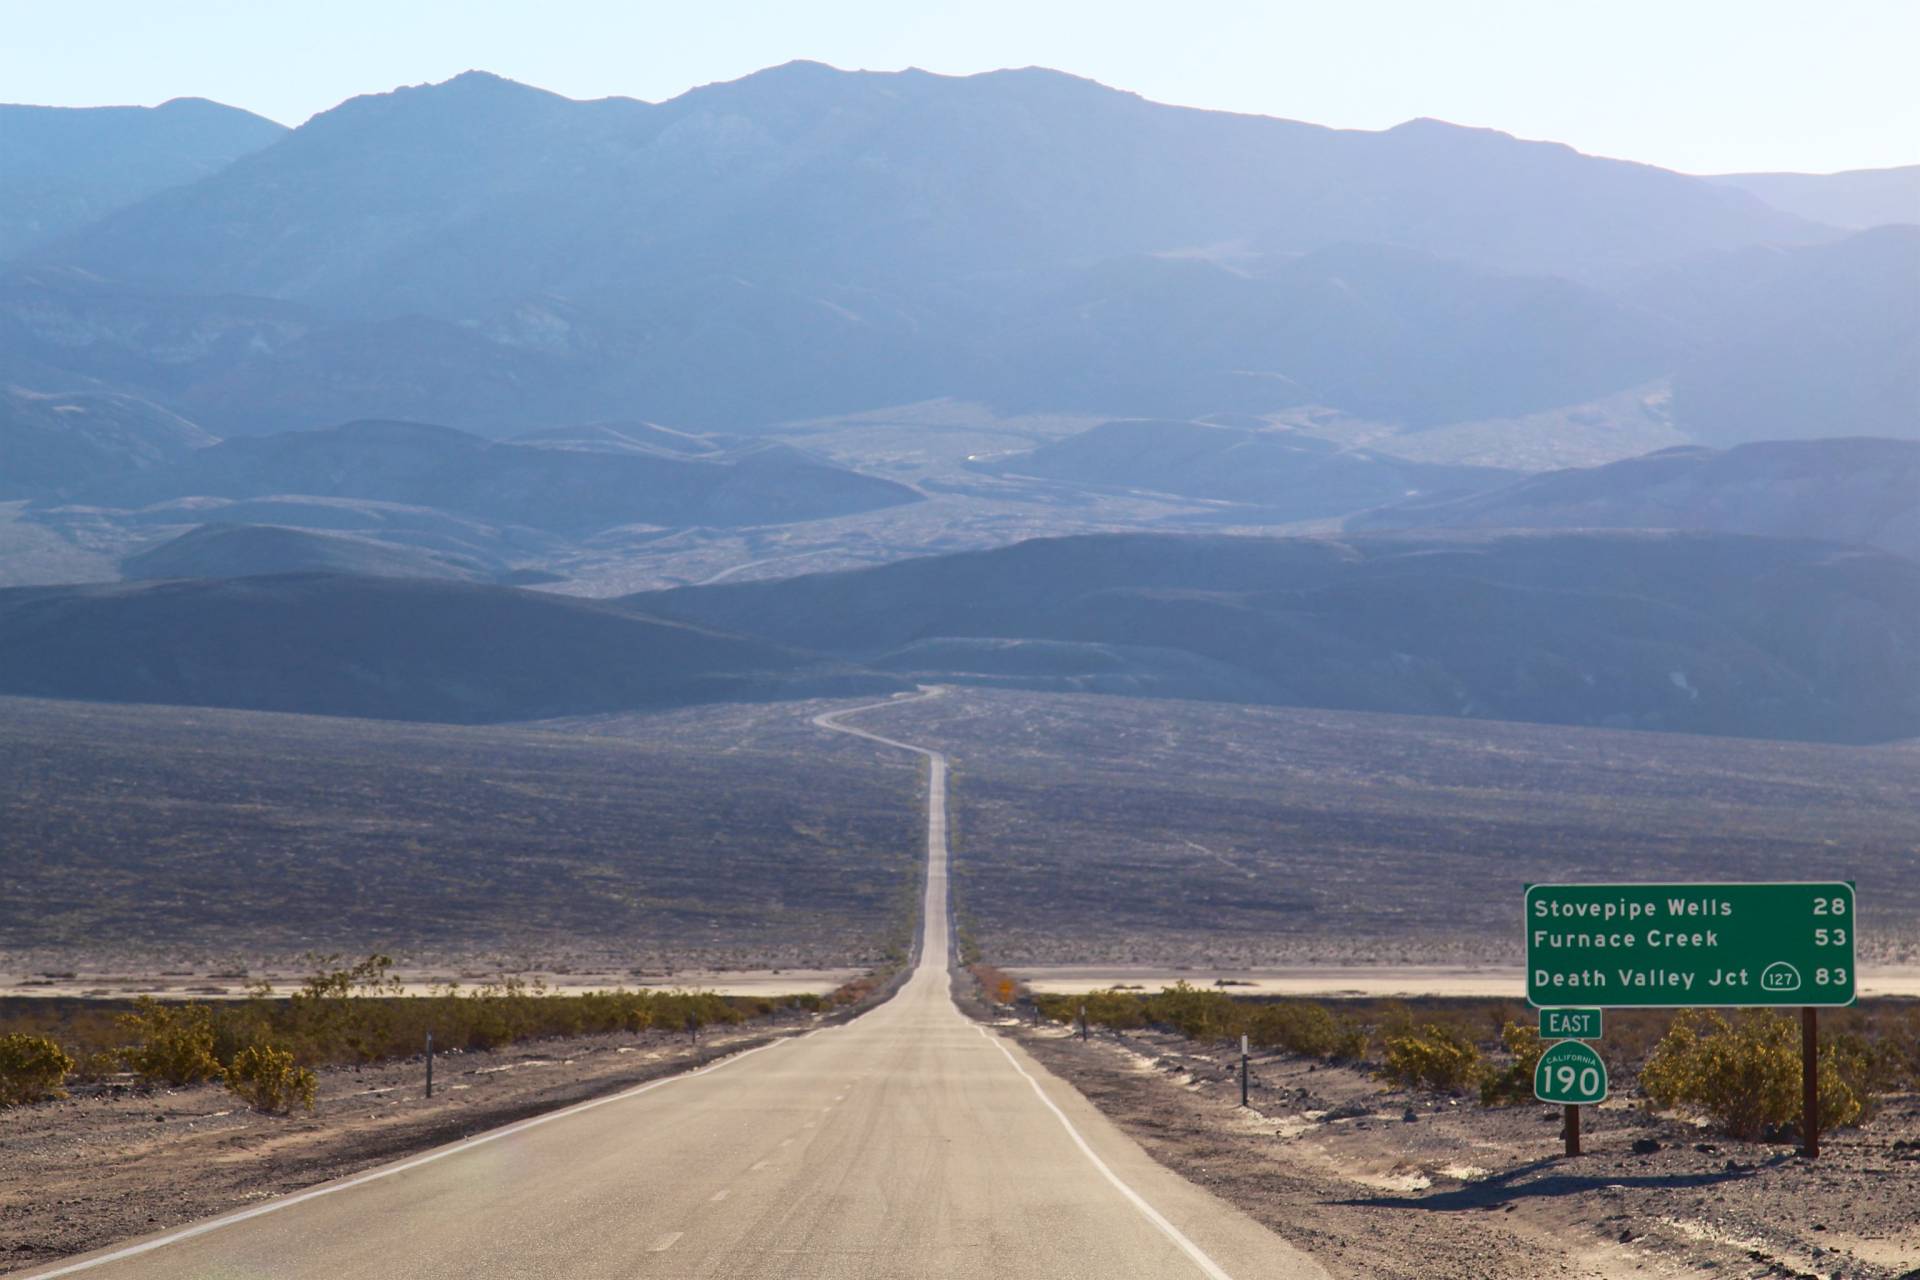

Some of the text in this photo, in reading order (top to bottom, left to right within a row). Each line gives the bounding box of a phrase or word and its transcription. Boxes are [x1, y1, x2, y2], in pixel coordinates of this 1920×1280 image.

[1535, 898, 1845, 920] Stovepipe Wells 28
[1535, 929, 1846, 947] Furnace Creek 53
[1536, 968, 1846, 990] Death Valley Jct 127 83
[1550, 1014, 1590, 1032] EAST
[1546, 1053, 1596, 1066] CALIFORNIA
[1544, 1066, 1599, 1095] 190
